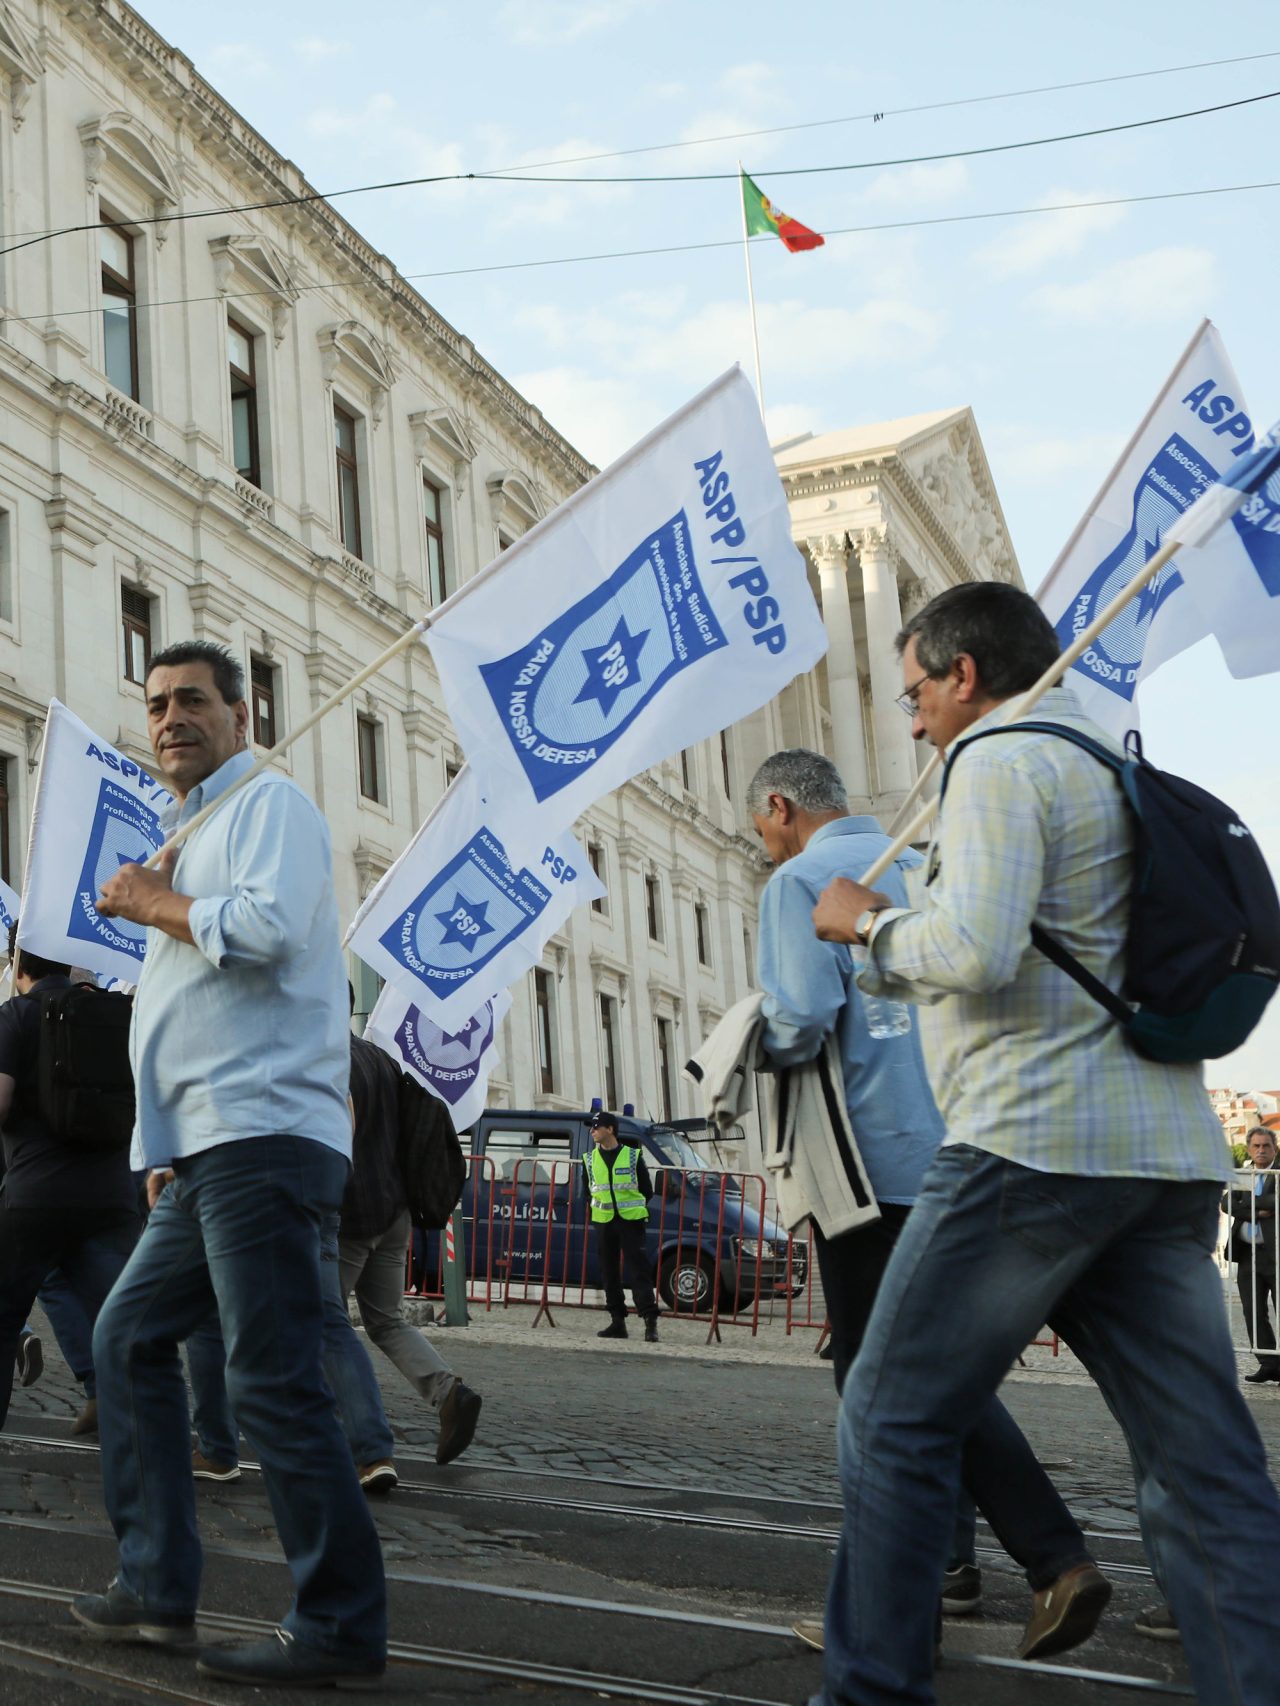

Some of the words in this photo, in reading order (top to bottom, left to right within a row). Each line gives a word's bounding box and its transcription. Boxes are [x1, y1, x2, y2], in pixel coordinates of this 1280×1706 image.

[1190, 487, 1201, 499] do
[694, 449, 787, 654] ASPP/PSP
[650, 539, 674, 609] Profissionais
[672, 521, 691, 591] Associação
[687, 592, 718, 646] Sindical
[673, 583, 683, 603] dos
[670, 609, 679, 625] da
[672, 625, 688, 661] Polícia
[514, 638, 555, 686] PARA
[597, 640, 629, 688] PSP
[1080, 646, 1121, 682] OSSA
[509, 691, 538, 749] NOSSA
[532, 743, 597, 765] DEFESA
[85, 743, 174, 806] ASPP/
[105, 785, 153, 822] Associação
[140, 820, 151, 832] dos
[468, 847, 508, 889] Profissionais
[507, 887, 516, 898] da
[515, 895, 536, 916] Polícia
[503, 872, 515, 884] dos
[521, 875, 548, 903] Sindical
[80, 892, 99, 925] PARA
[96, 923, 136, 952] NOSSA
[449, 907, 480, 937] PSP
[401, 912, 416, 945] PARA
[426, 967, 475, 980] DEFESA
[404, 1020, 415, 1050] PARA
[410, 1050, 433, 1075] NOSSA
[435, 1068, 476, 1081] DEFESA
[493, 1202, 557, 1221] POLÍCIA
